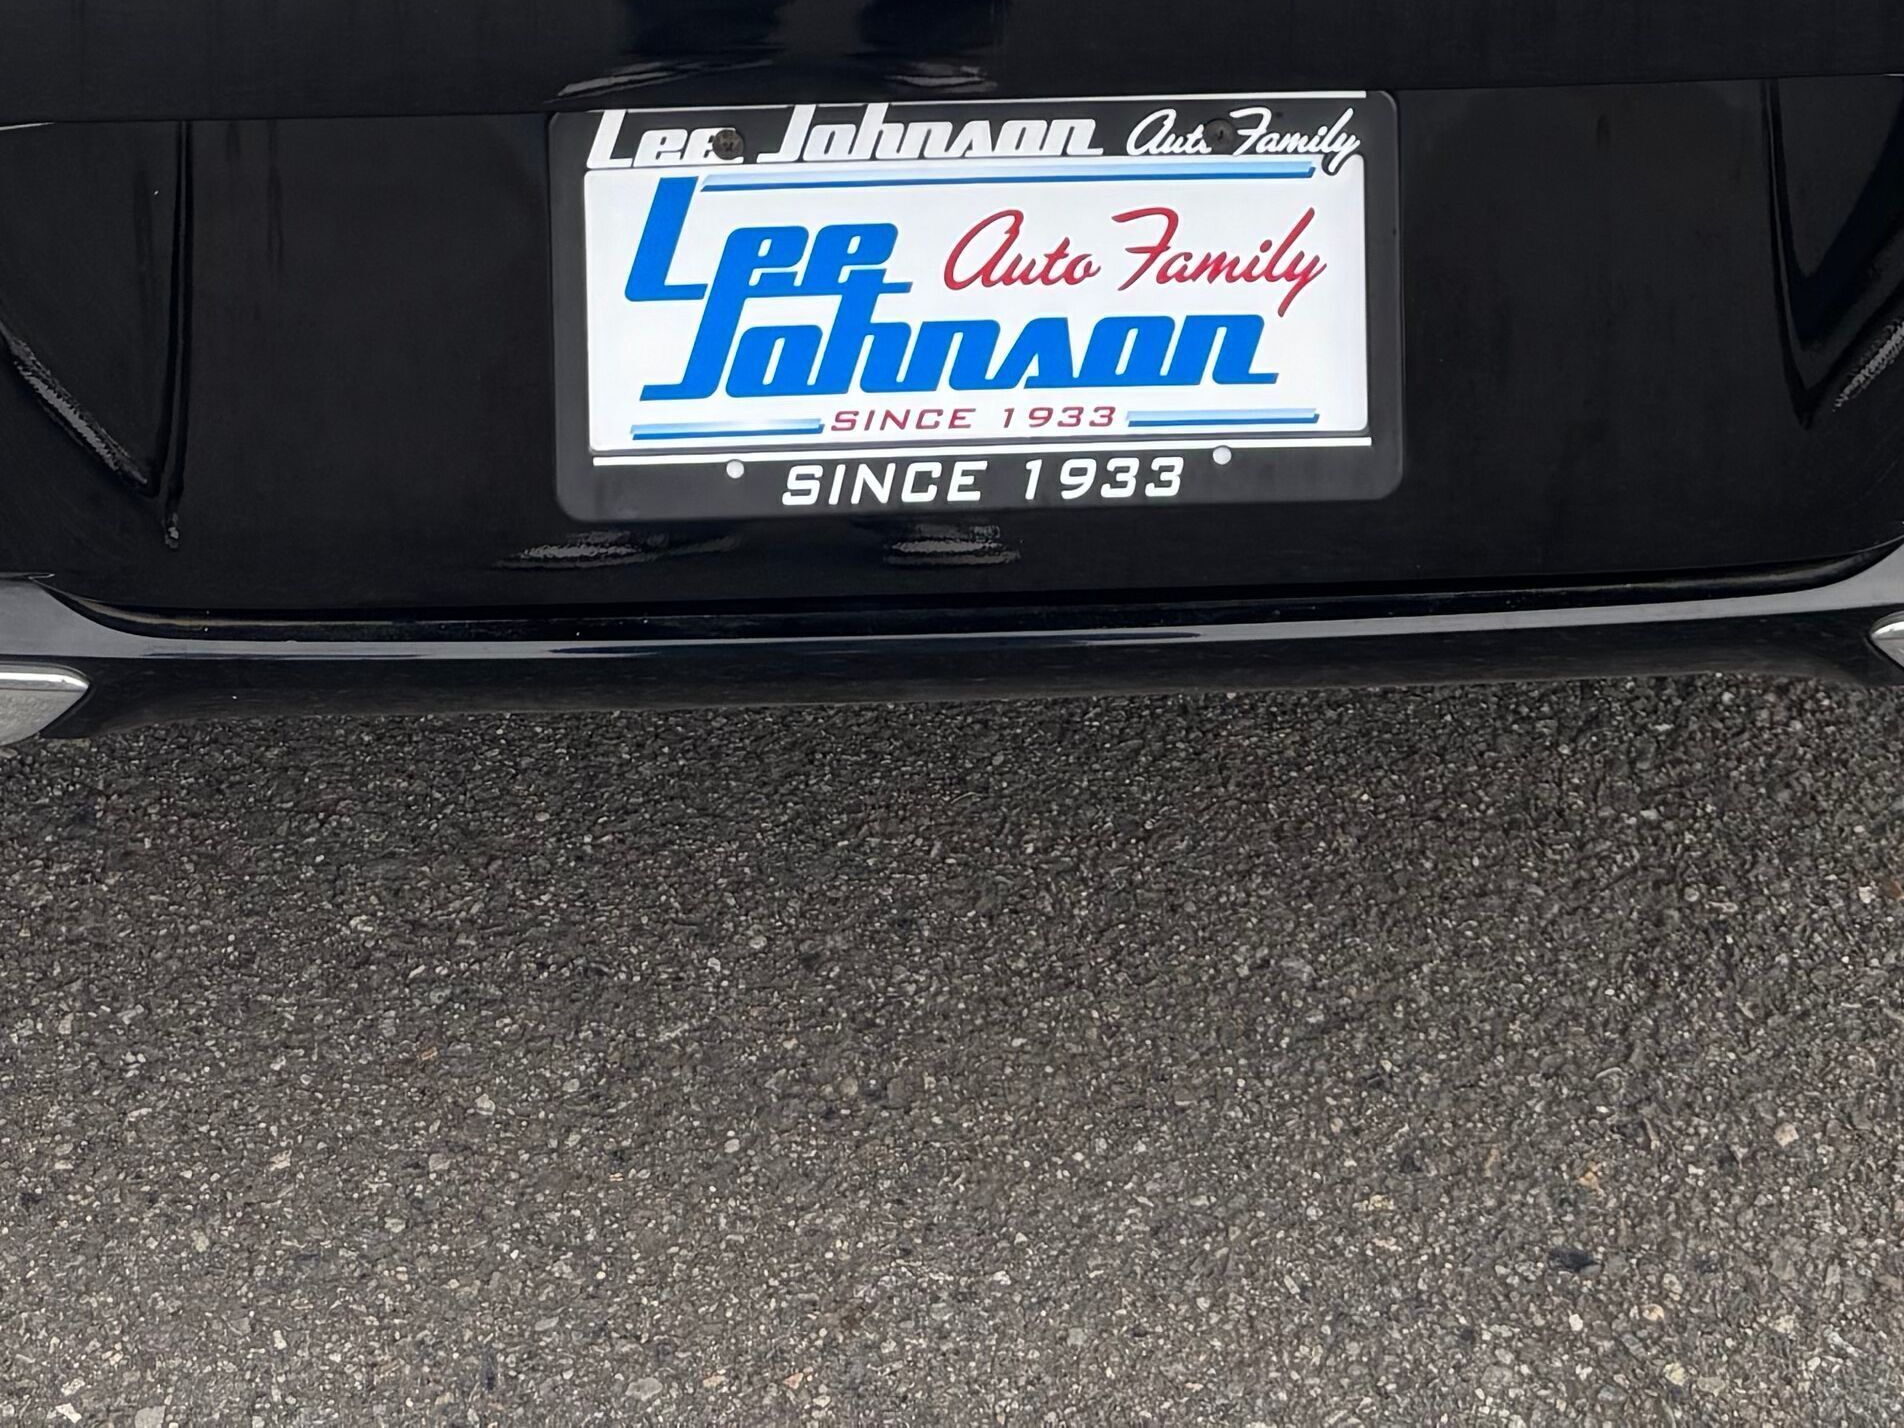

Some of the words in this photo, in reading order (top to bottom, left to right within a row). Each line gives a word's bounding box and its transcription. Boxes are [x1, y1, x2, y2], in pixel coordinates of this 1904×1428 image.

[756, 102, 1104, 164] Johnson
[1125, 108, 1214, 157] Aut
[1229, 106, 1362, 174] Family
[624, 176, 913, 302] Lee
[942, 207, 1102, 292] Auto
[1110, 206, 1328, 317] Family
[639, 264, 1279, 402] Johnson
[831, 407, 978, 433] SINCE
[999, 404, 1117, 431] 1933
[781, 457, 984, 507] SINCE
[1023, 454, 1186, 500] 1933
